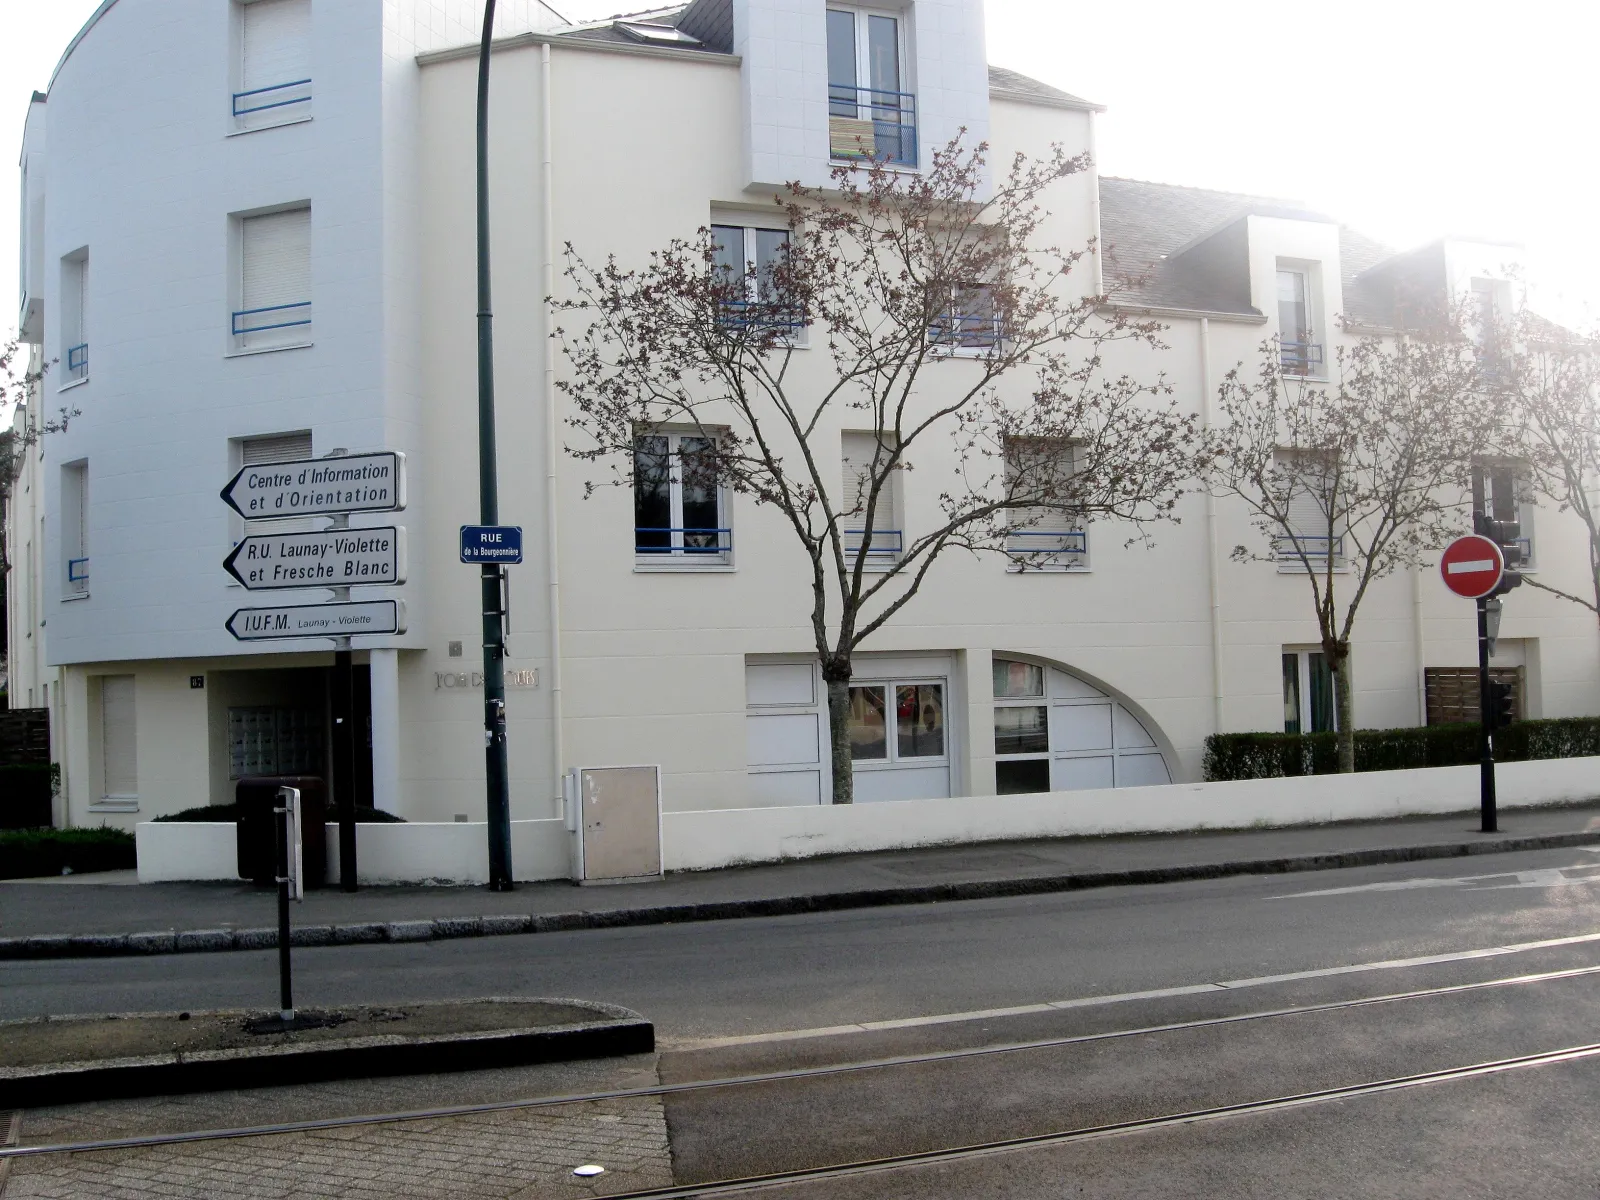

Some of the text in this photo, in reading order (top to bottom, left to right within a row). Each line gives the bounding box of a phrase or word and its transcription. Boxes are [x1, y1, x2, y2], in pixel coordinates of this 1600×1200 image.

[248, 473, 292, 489] Centre
[249, 497, 265, 510] et
[480, 533, 503, 543] RUE
[248, 537, 389, 560] R.U. Launay-Violette
[464, 547, 519, 558] de la Bourgeonnière
[249, 560, 389, 581] et Fresche Blanc
[245, 614, 291, 631] I.U.F.M.
[298, 617, 330, 629] Launay
[338, 614, 371, 625] Violette
